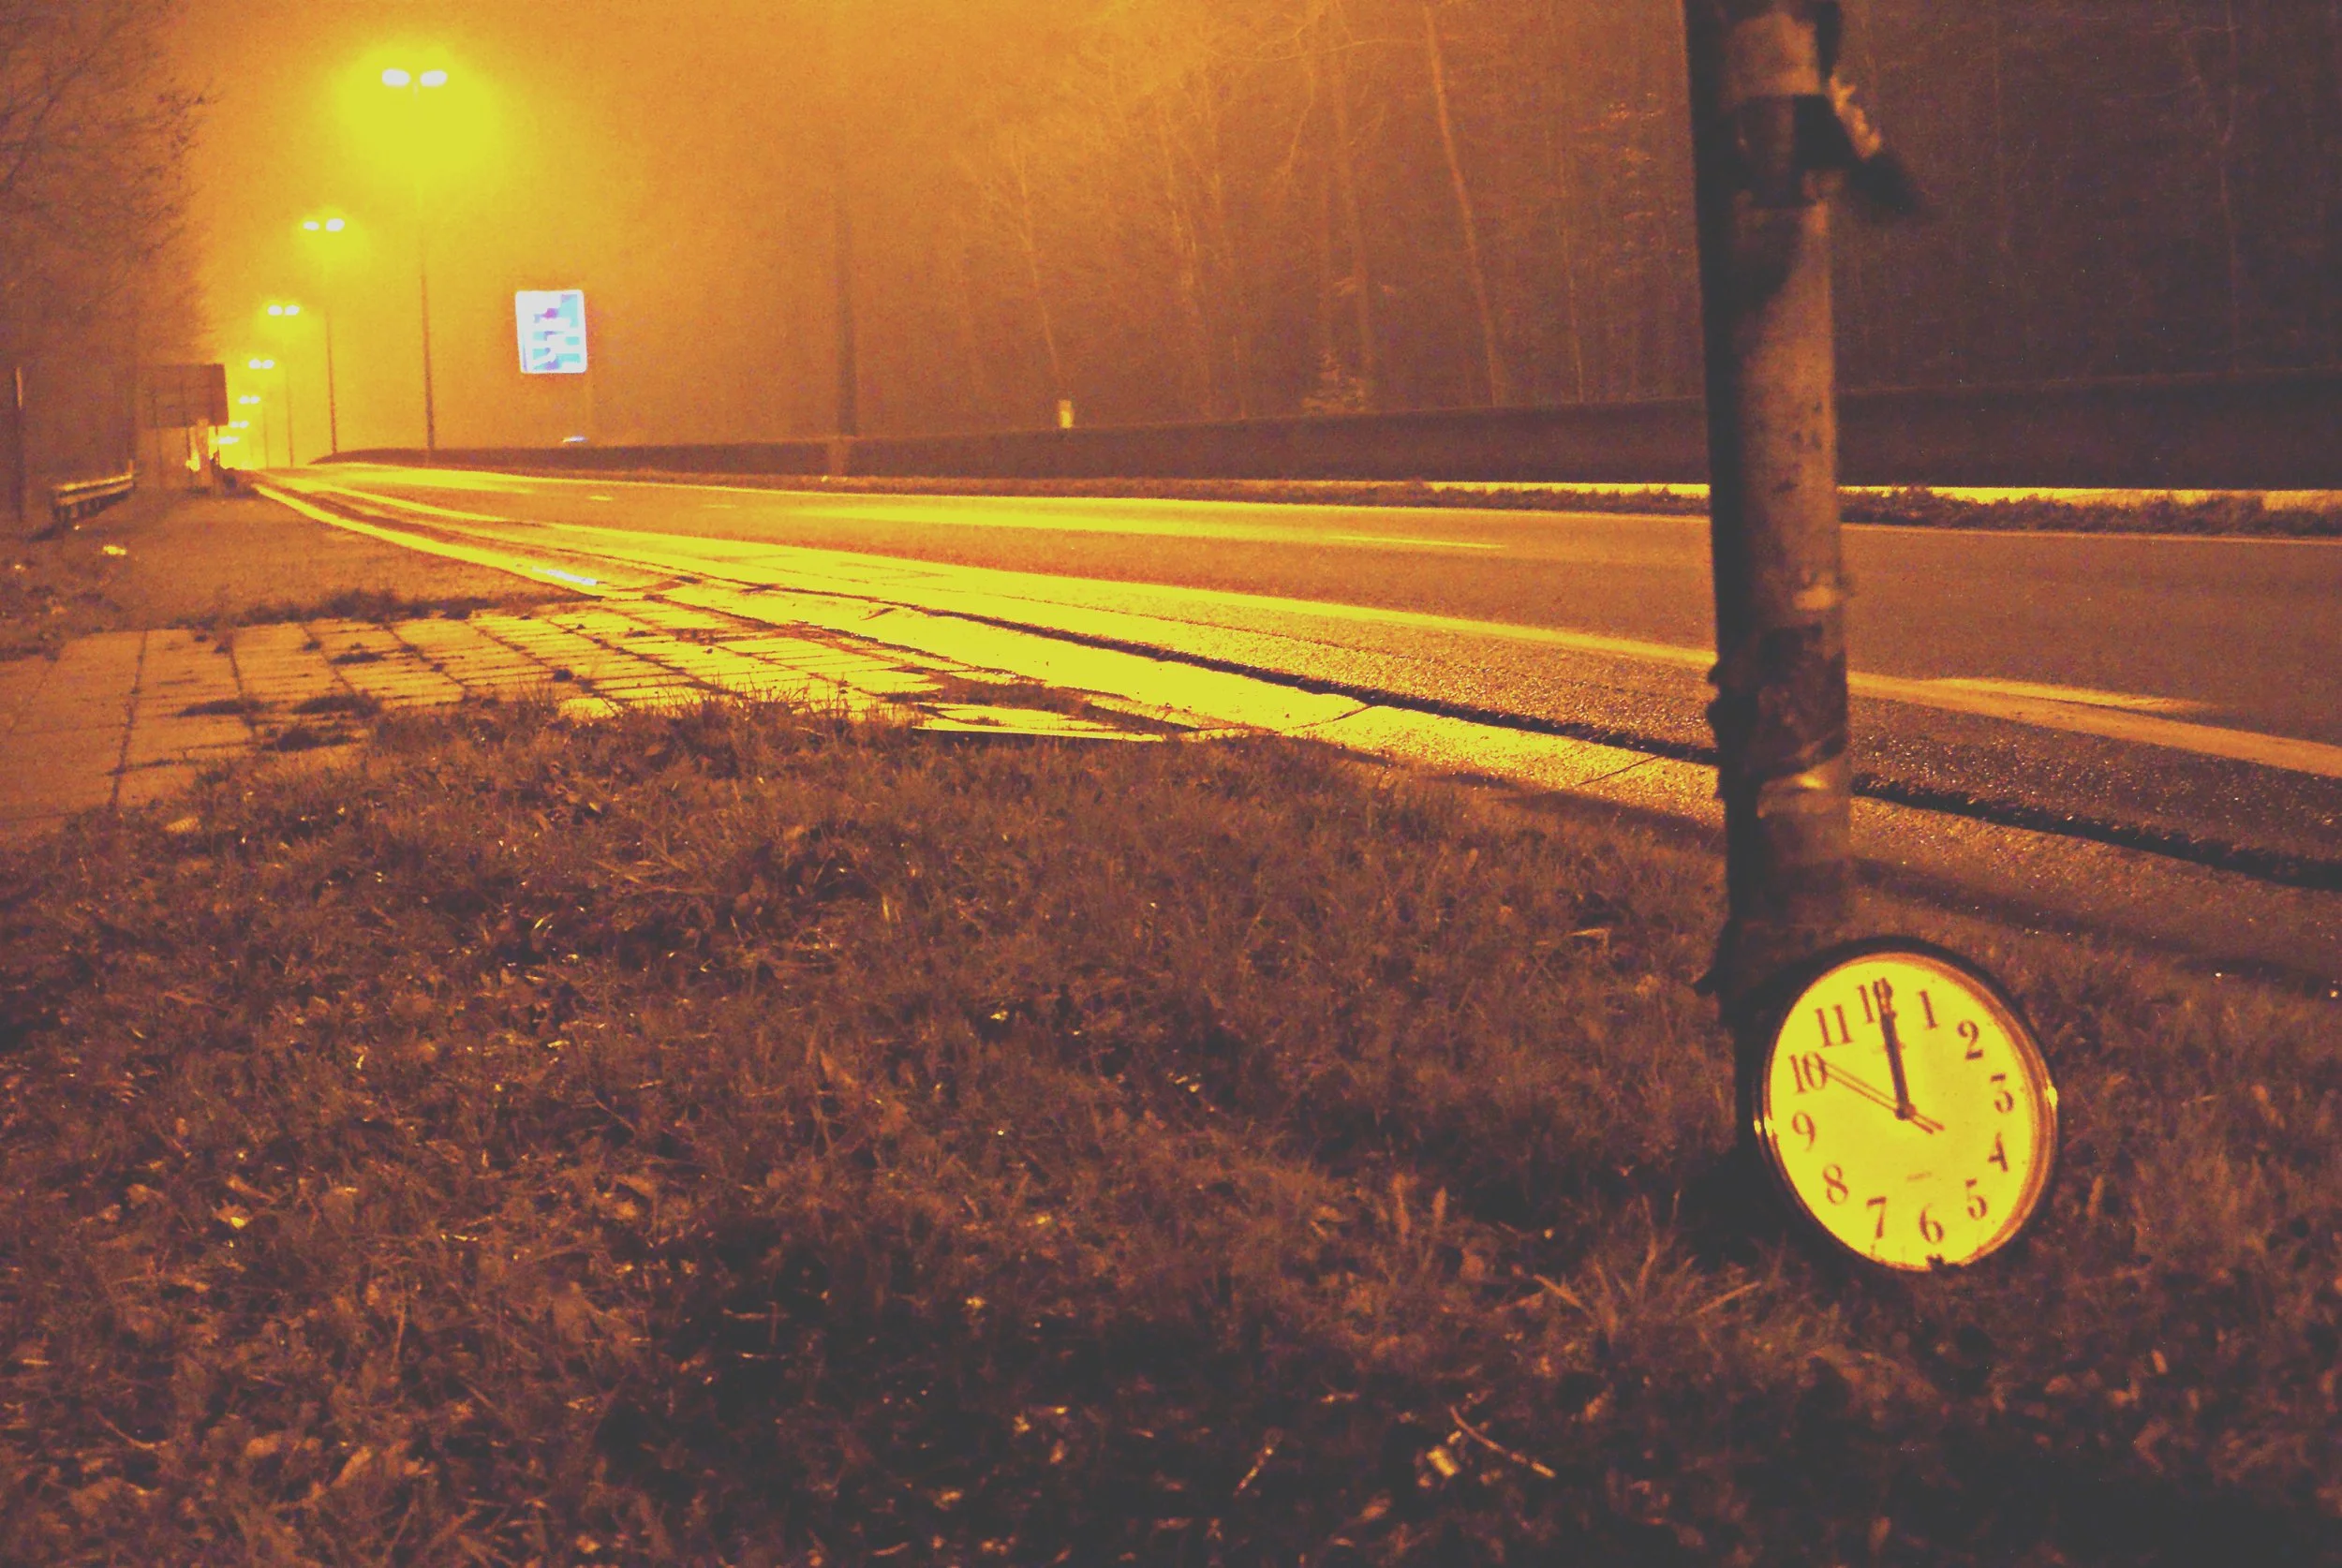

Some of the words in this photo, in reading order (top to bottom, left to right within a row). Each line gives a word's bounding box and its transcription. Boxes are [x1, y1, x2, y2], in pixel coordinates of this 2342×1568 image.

[1815, 1004, 1853, 1047] 11
[1919, 990, 1938, 1029] 1
[1957, 1019, 1984, 1059] 2
[1788, 1051, 1829, 1095] 10
[1990, 1072, 2014, 1113] 3
[1791, 1112, 1816, 1152] 9
[1988, 1132, 2008, 1172] 4
[1822, 1164, 1848, 1206] 8
[1965, 1178, 1987, 1220] 5
[1866, 1196, 1887, 1239] 7
[1919, 1204, 1944, 1245] 6
